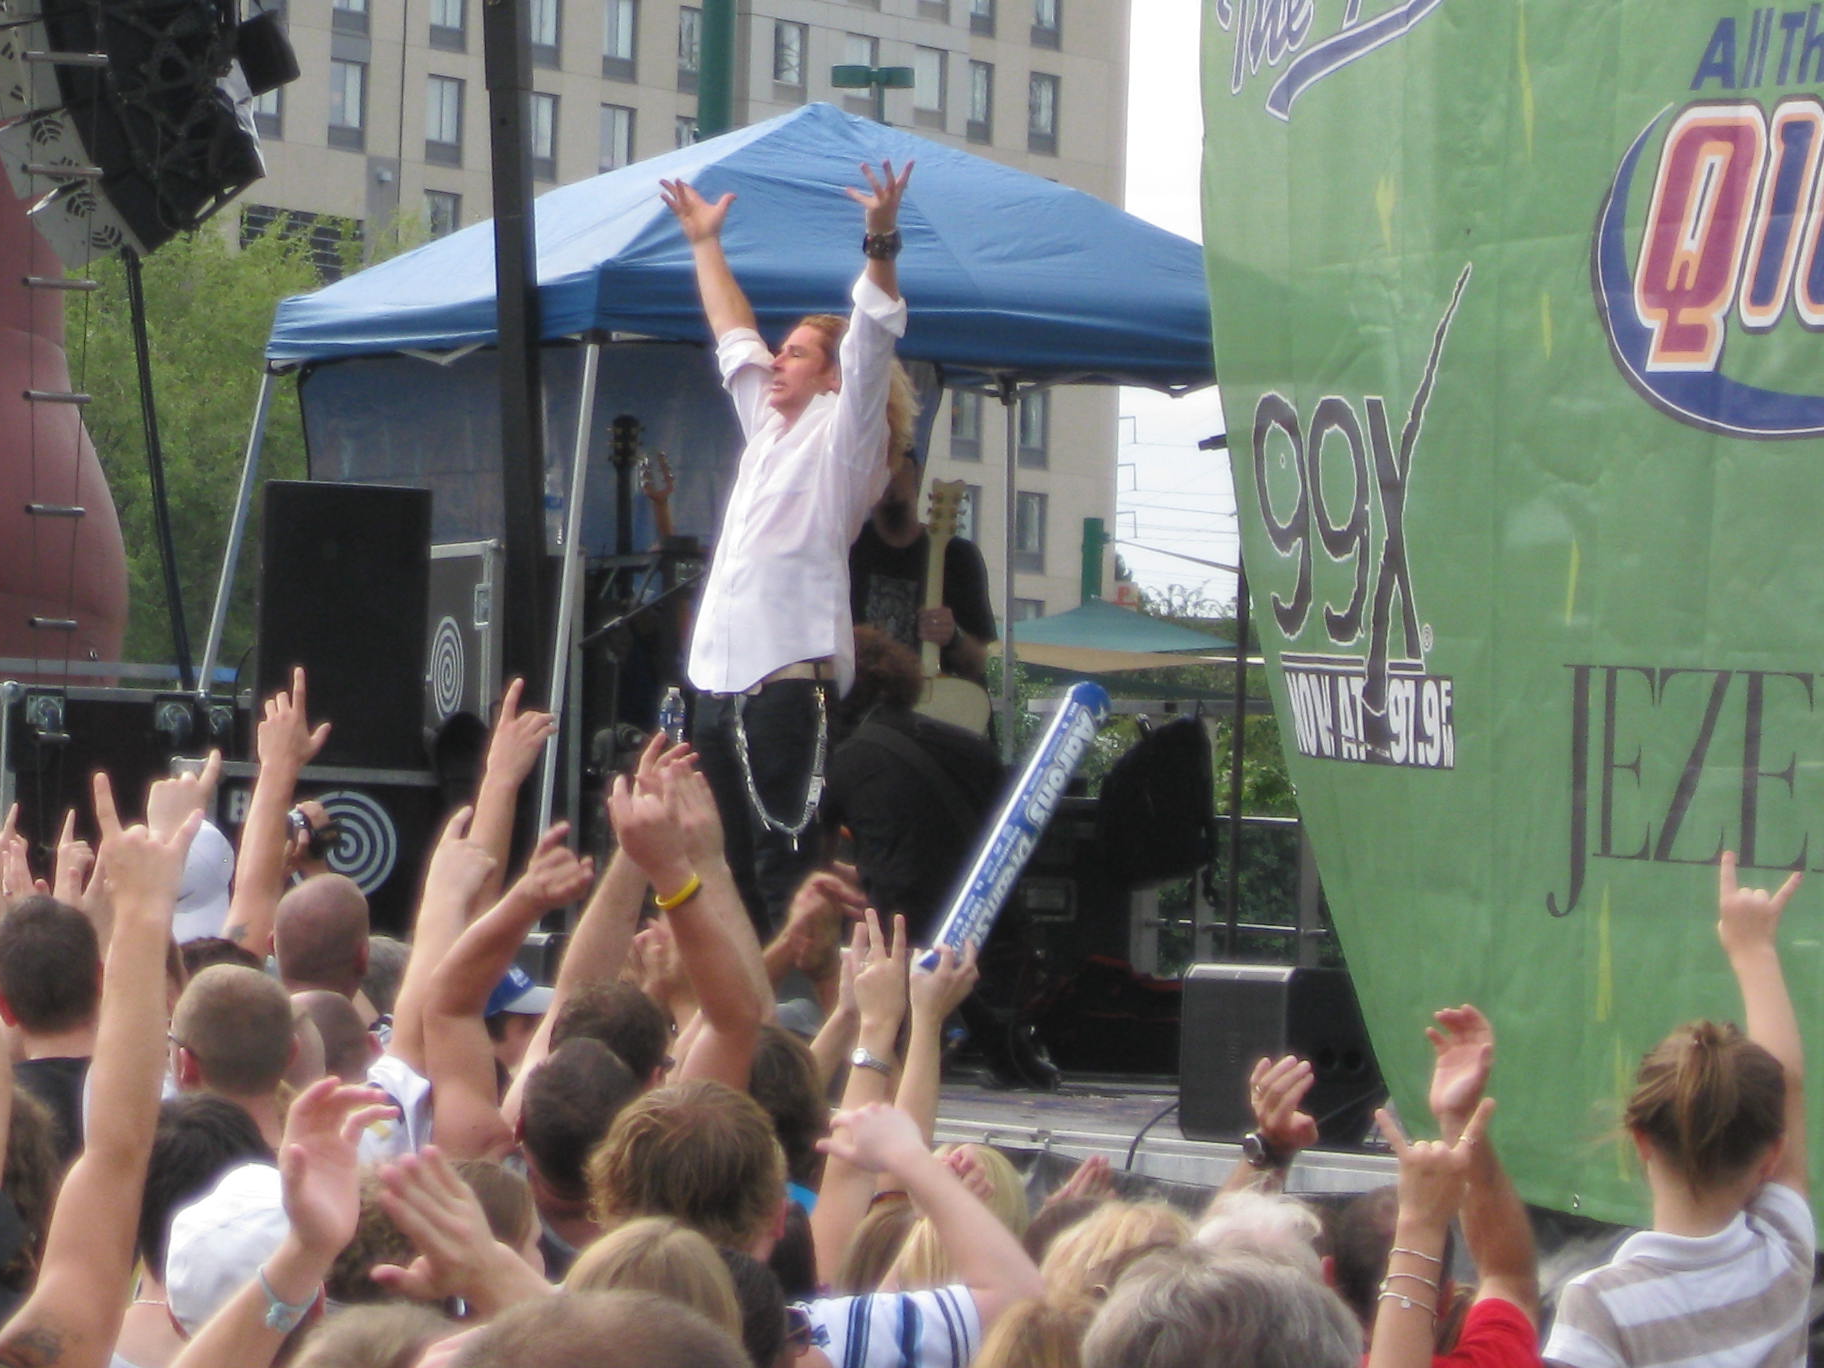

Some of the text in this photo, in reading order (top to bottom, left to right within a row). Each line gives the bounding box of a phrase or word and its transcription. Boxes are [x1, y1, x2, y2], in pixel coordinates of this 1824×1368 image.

[1690, 6, 1775, 91] All
[1285, 672, 1336, 758] NOW
[1337, 675, 1367, 761] AT
[1389, 678, 1442, 766] 97.9
